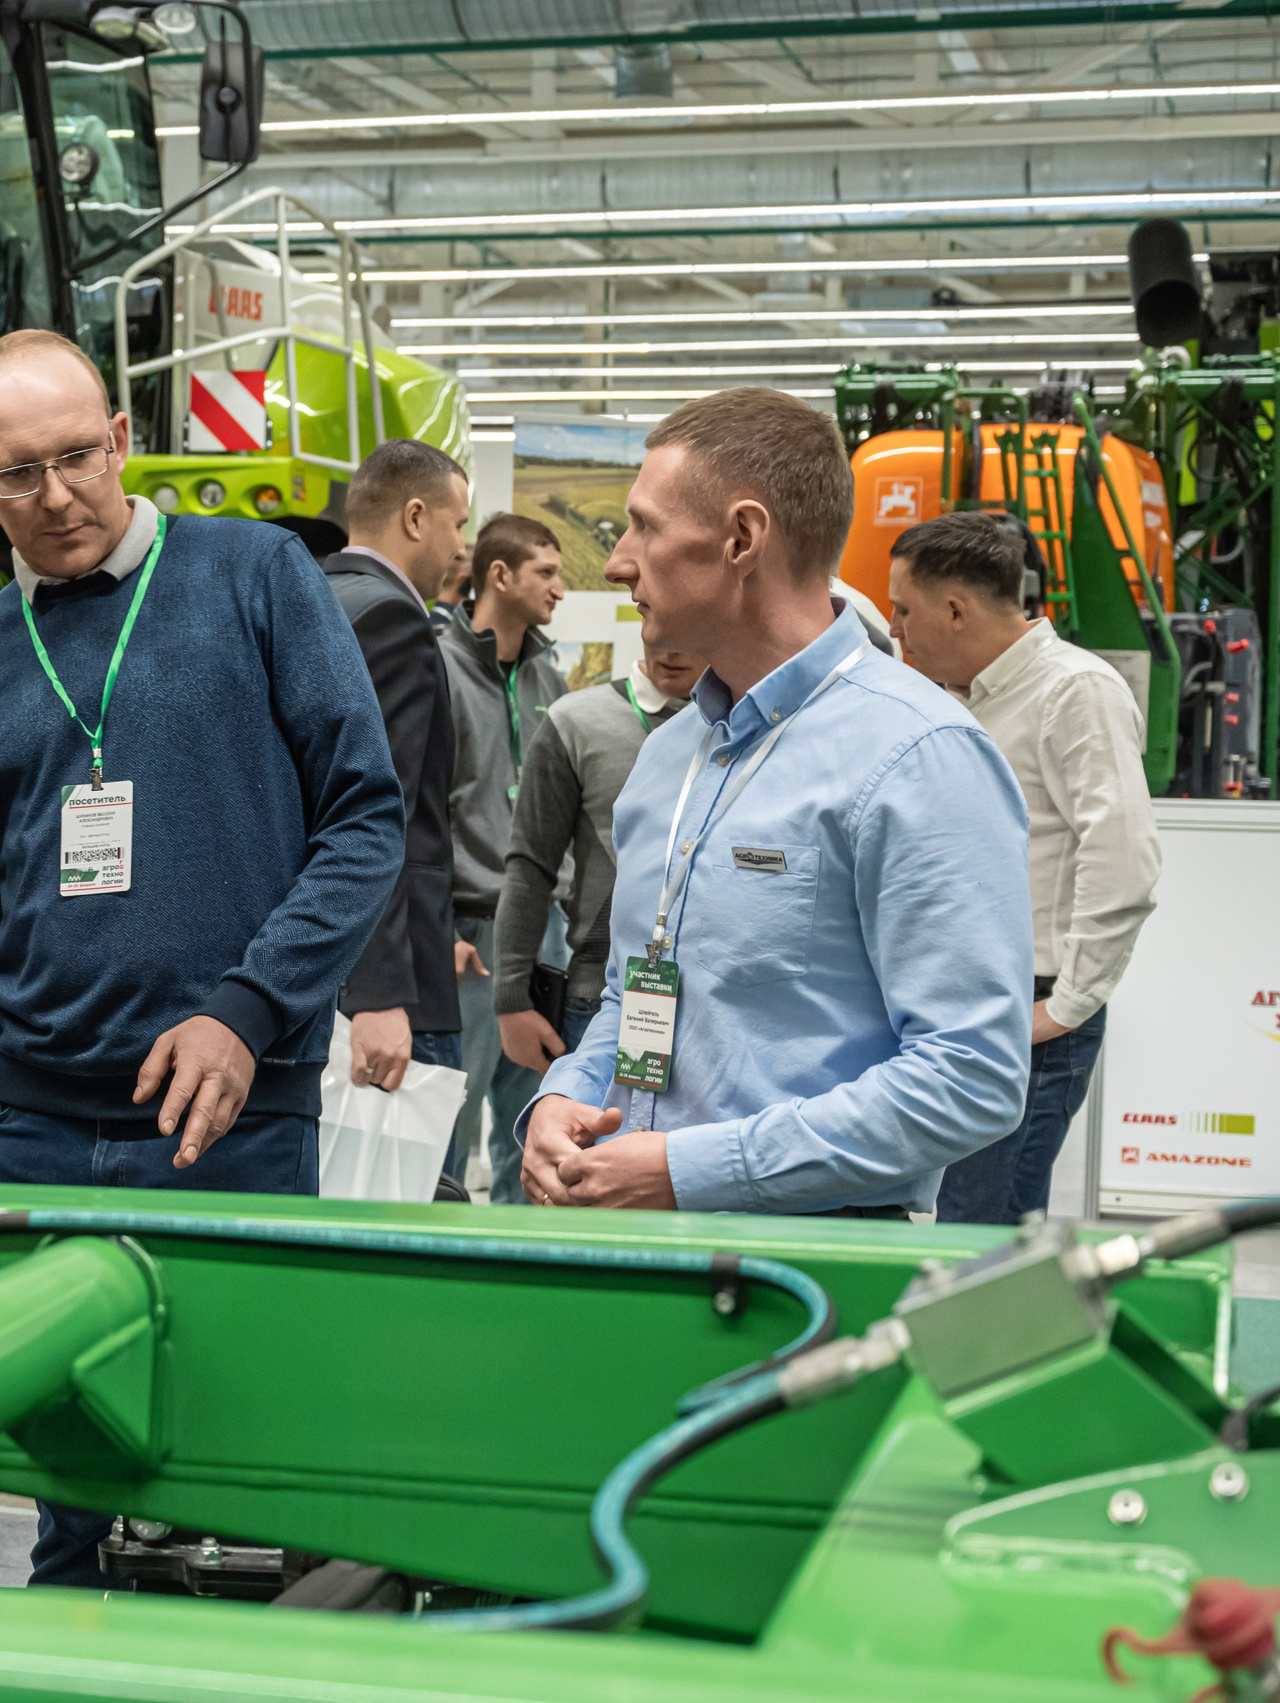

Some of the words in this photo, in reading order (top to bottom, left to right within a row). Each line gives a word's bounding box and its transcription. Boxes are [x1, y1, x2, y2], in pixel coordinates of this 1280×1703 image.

[69, 795, 126, 806] посетитель
[102, 871, 124, 879] техно
[629, 970, 661, 981] участник
[640, 981, 673, 992] выставки
[646, 1058, 661, 1067] агро
[646, 1067, 664, 1076] техно
[644, 1075, 663, 1084] логии
[1122, 1112, 1178, 1126] CLAAS
[1146, 1152, 1252, 1168] AMAZONE
